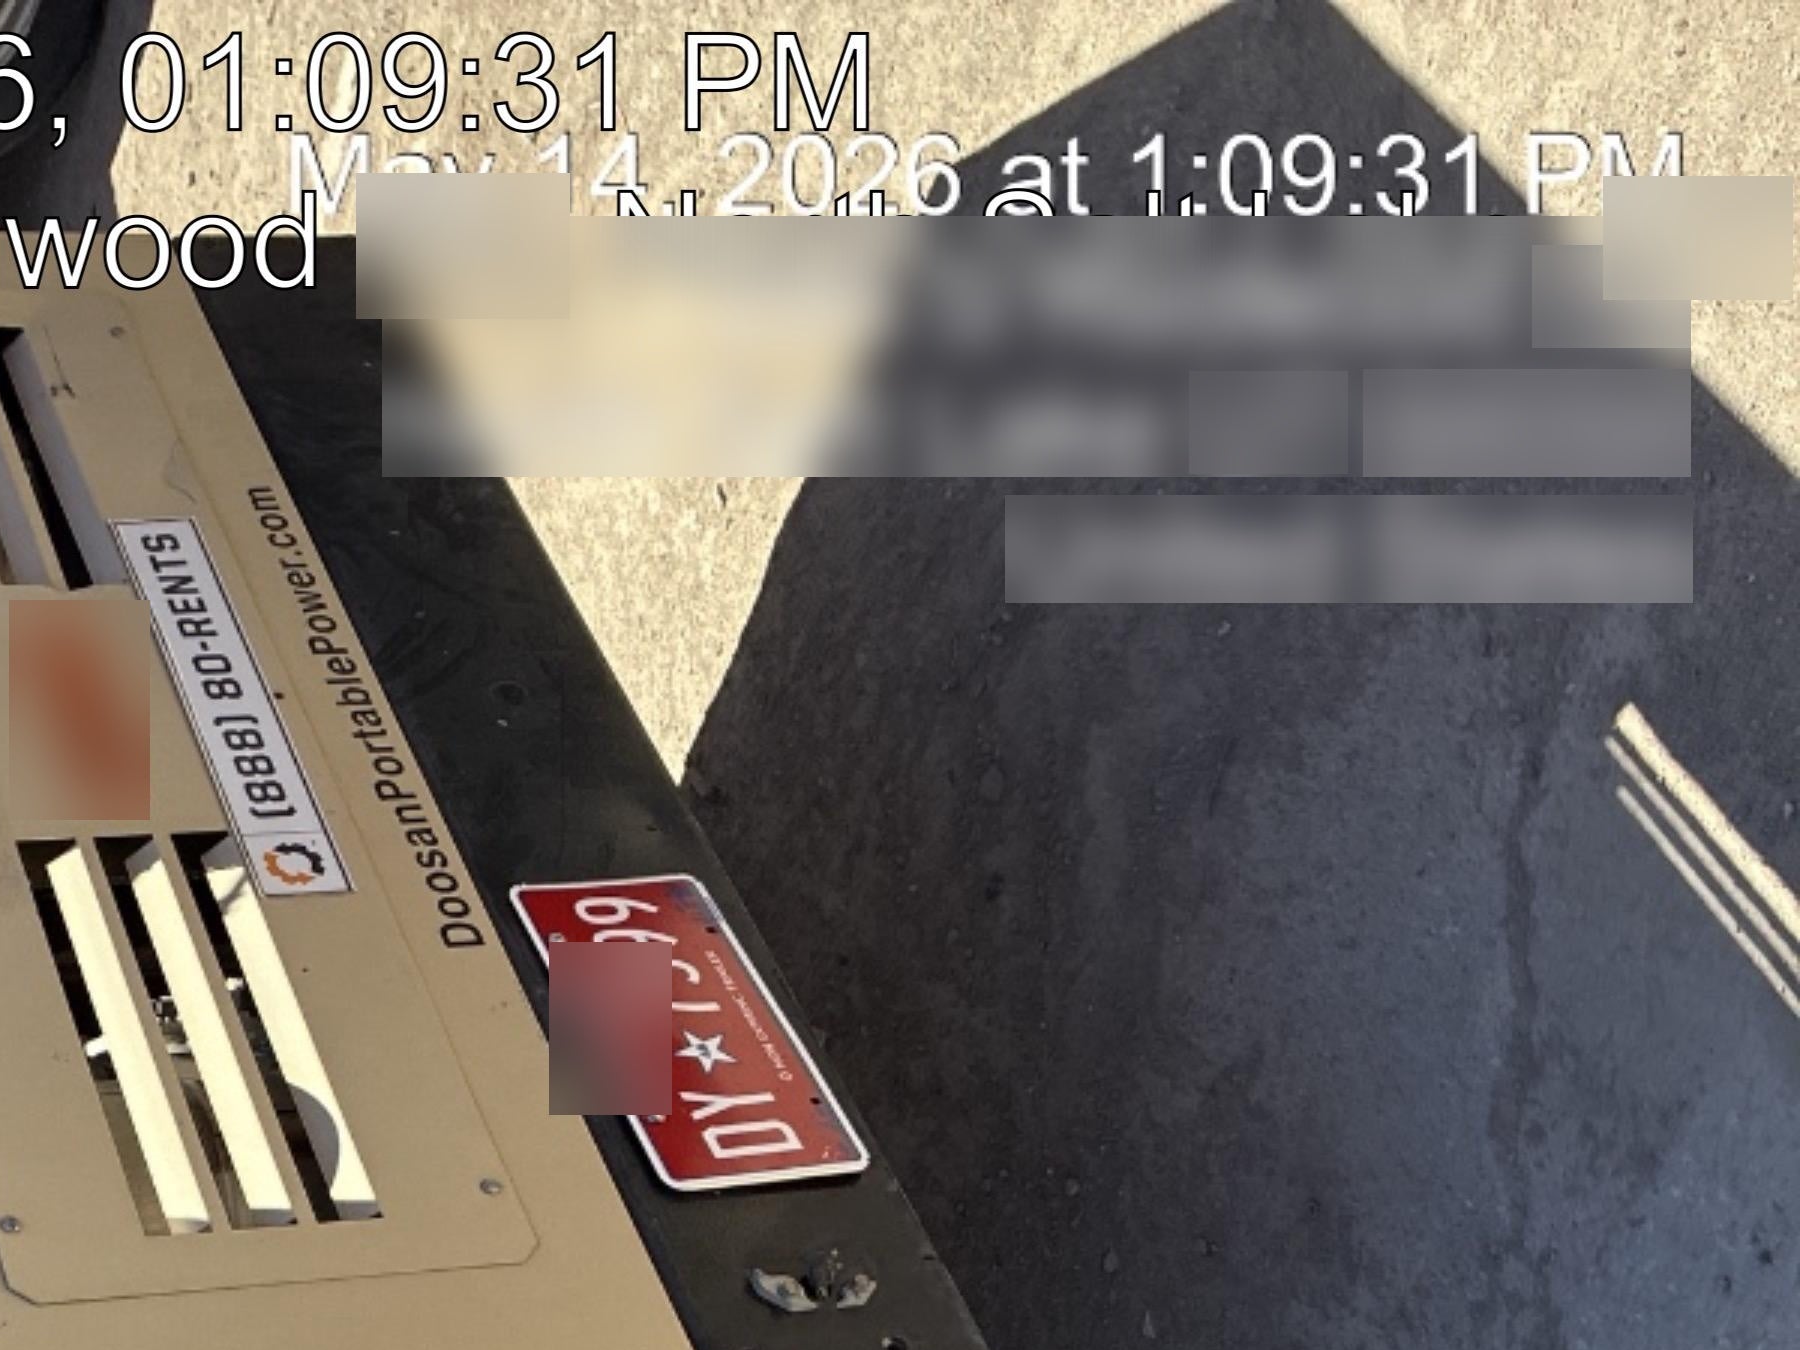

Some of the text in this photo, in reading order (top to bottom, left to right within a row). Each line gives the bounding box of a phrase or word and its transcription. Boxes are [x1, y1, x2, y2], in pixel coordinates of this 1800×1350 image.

[140, 533, 296, 818] (888) 80-RENTS
[245, 487, 486, 948] DoosanPortablePower.com
[679, 1091, 805, 1159] DY
